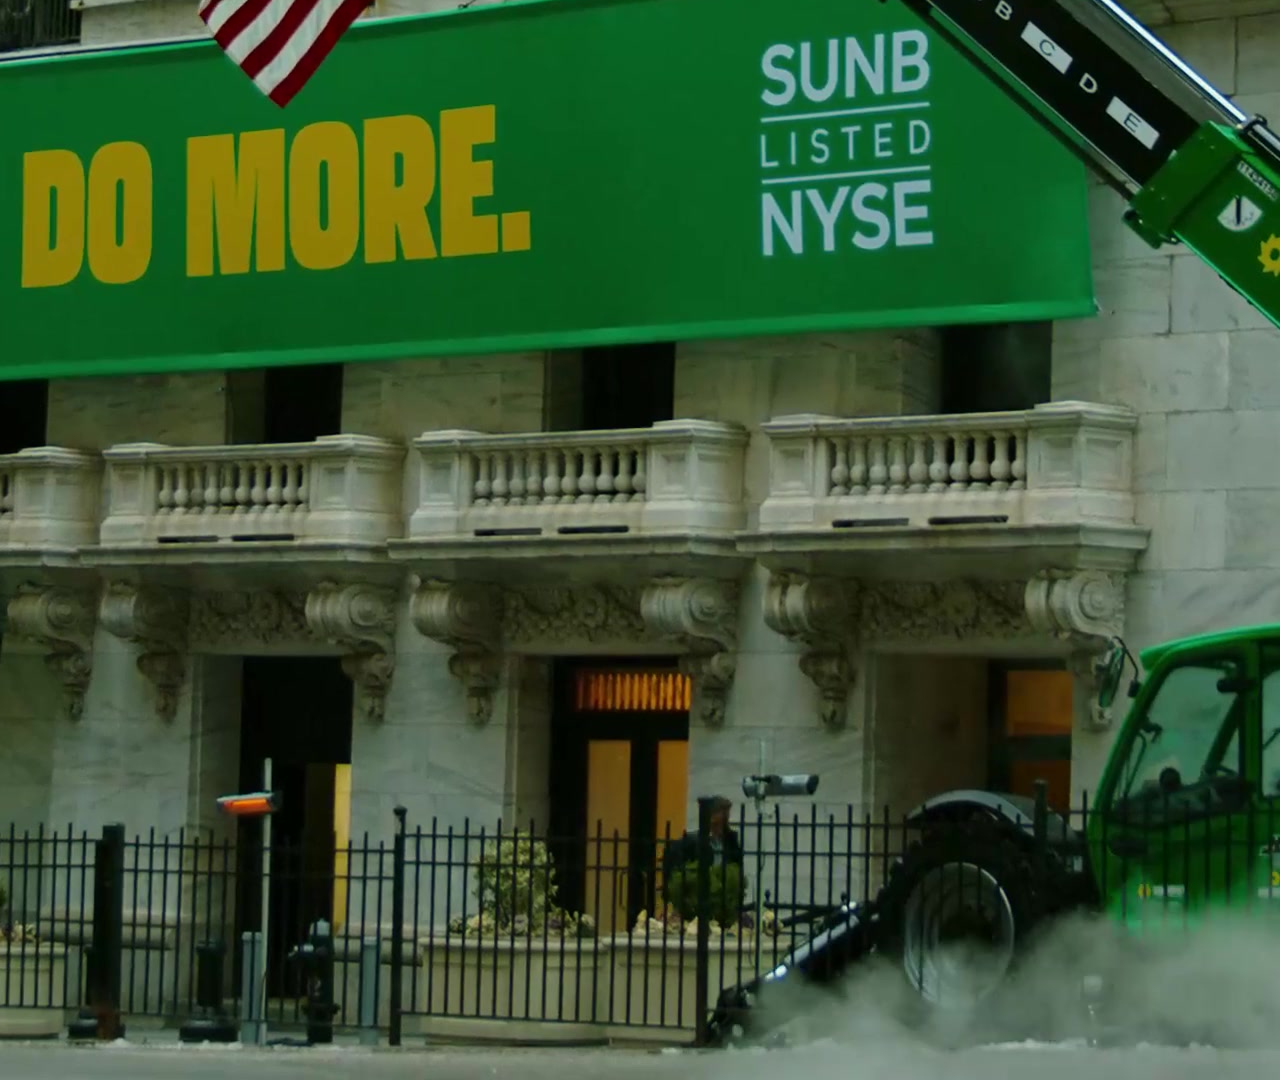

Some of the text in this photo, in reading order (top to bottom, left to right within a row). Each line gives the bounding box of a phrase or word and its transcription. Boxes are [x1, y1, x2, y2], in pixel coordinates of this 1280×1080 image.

[762, 31, 930, 105] SUNB
[995, 0, 1013, 21] B
[1039, 39, 1056, 57] C
[1079, 72, 1098, 94] D
[1123, 112, 1142, 133] E
[762, 120, 930, 166] LISTED
[22, 142, 151, 286] DO
[188, 106, 530, 275] MORE.
[763, 181, 933, 255] NYSE
